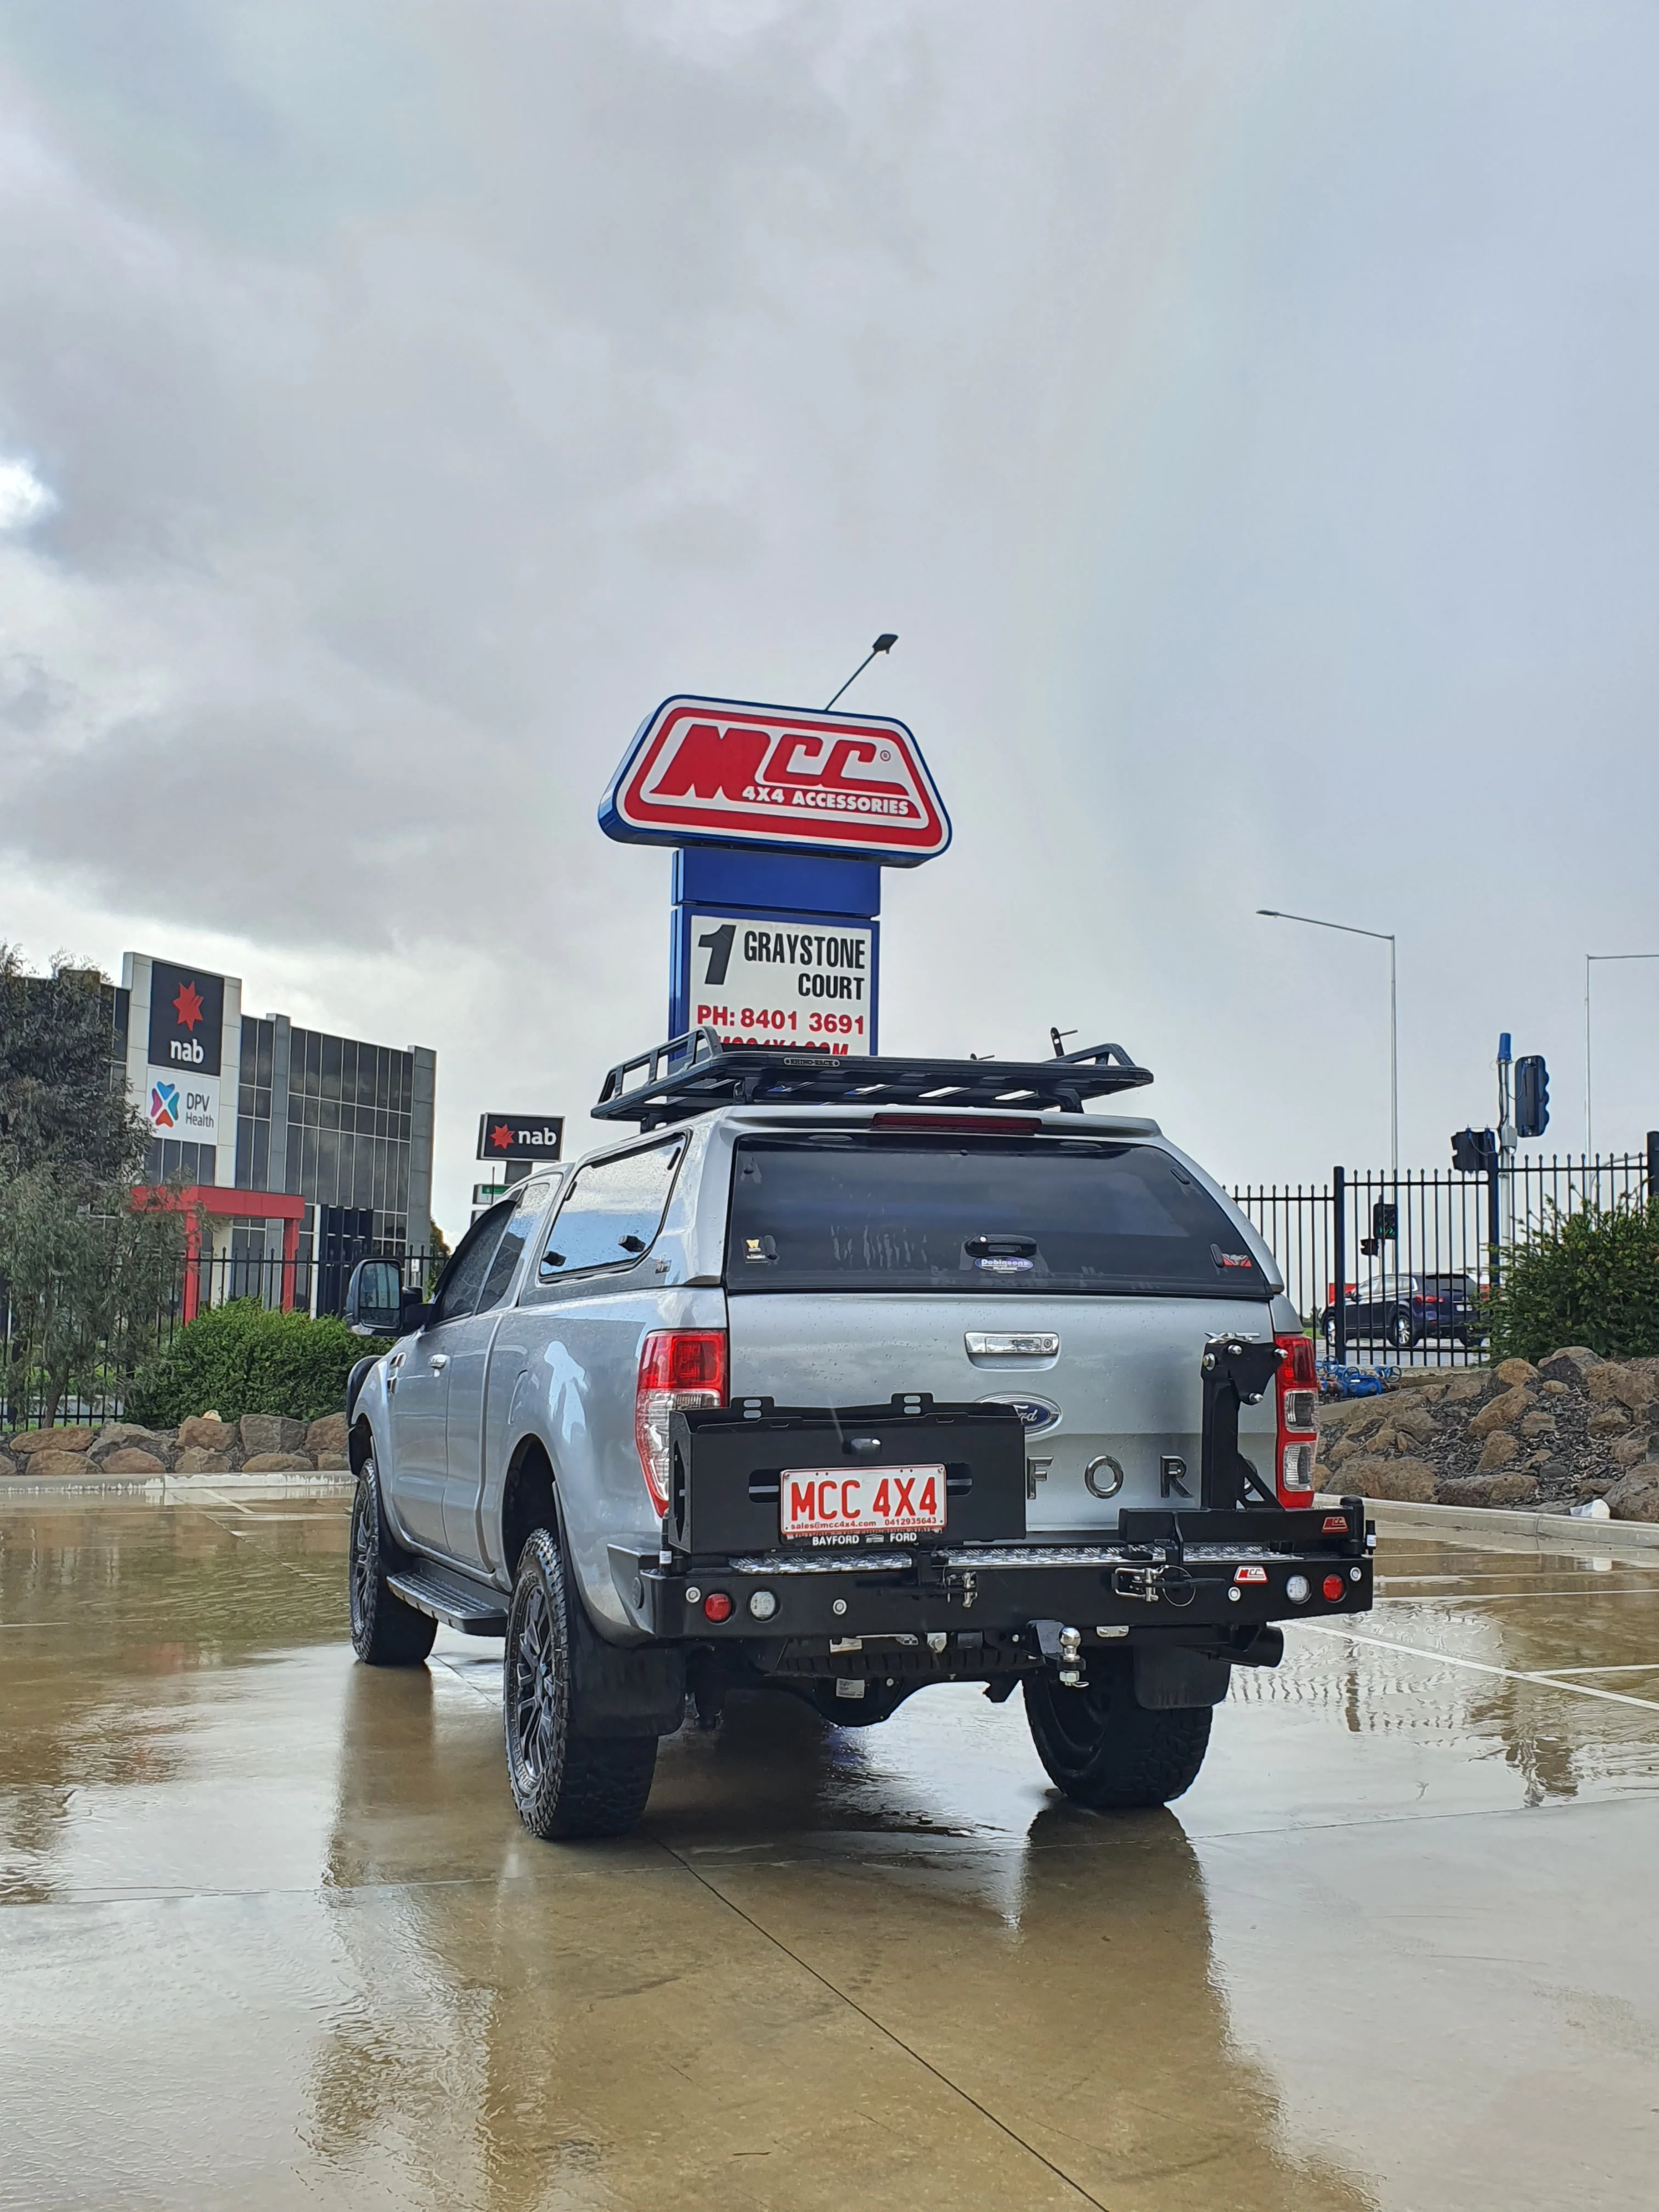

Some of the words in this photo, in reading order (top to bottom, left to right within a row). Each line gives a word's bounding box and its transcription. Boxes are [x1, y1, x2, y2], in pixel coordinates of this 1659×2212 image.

[649, 724, 910, 801] MCC
[742, 786, 785, 803] 4X4
[792, 791, 909, 815] ACCESSORIES
[697, 924, 736, 985] 1
[744, 930, 865, 969] GRAYSTONE
[798, 973, 865, 1000] COURT
[697, 1005, 735, 1026] PH:
[740, 1008, 797, 1030] 8401
[809, 1012, 864, 1035] 3691
[170, 1038, 204, 1064] nab
[186, 1092, 211, 1112] DPV
[185, 1111, 215, 1128] Health
[518, 1127, 557, 1146] nab
[1026, 1454, 1257, 1500] FOR
[791, 1480, 861, 1521] MCC
[872, 1476, 938, 1517] 4X4
[791, 1520, 877, 1530] sales@mcc4x4.com
[884, 1517, 936, 1526] 0412935643
[812, 1534, 860, 1546] BAYFORD
[890, 1532, 917, 1543] FORD
